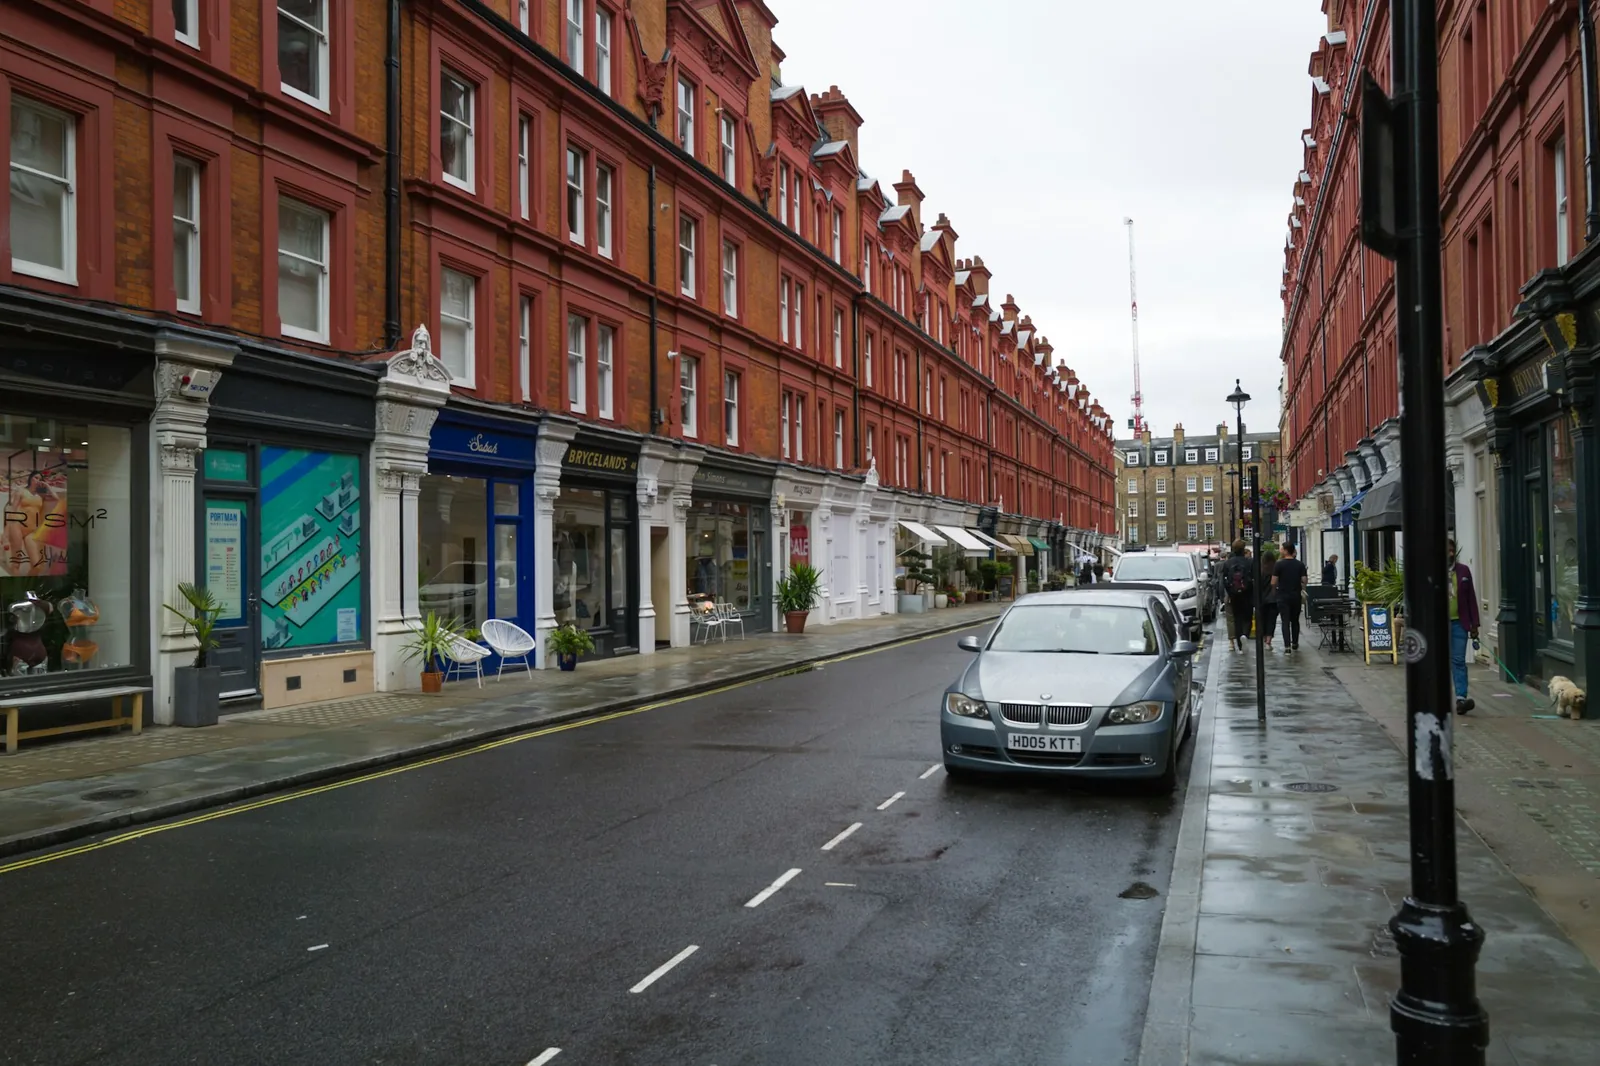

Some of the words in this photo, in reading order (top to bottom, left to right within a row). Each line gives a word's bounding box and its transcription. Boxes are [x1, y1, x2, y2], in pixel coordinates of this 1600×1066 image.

[469, 433, 498, 453] Sabah
[568, 449, 628, 470] BRYCELAND'S
[209, 512, 238, 521] PORTMAN
[1012, 735, 1046, 749] HD05
[1049, 737, 1075, 750] KTT
